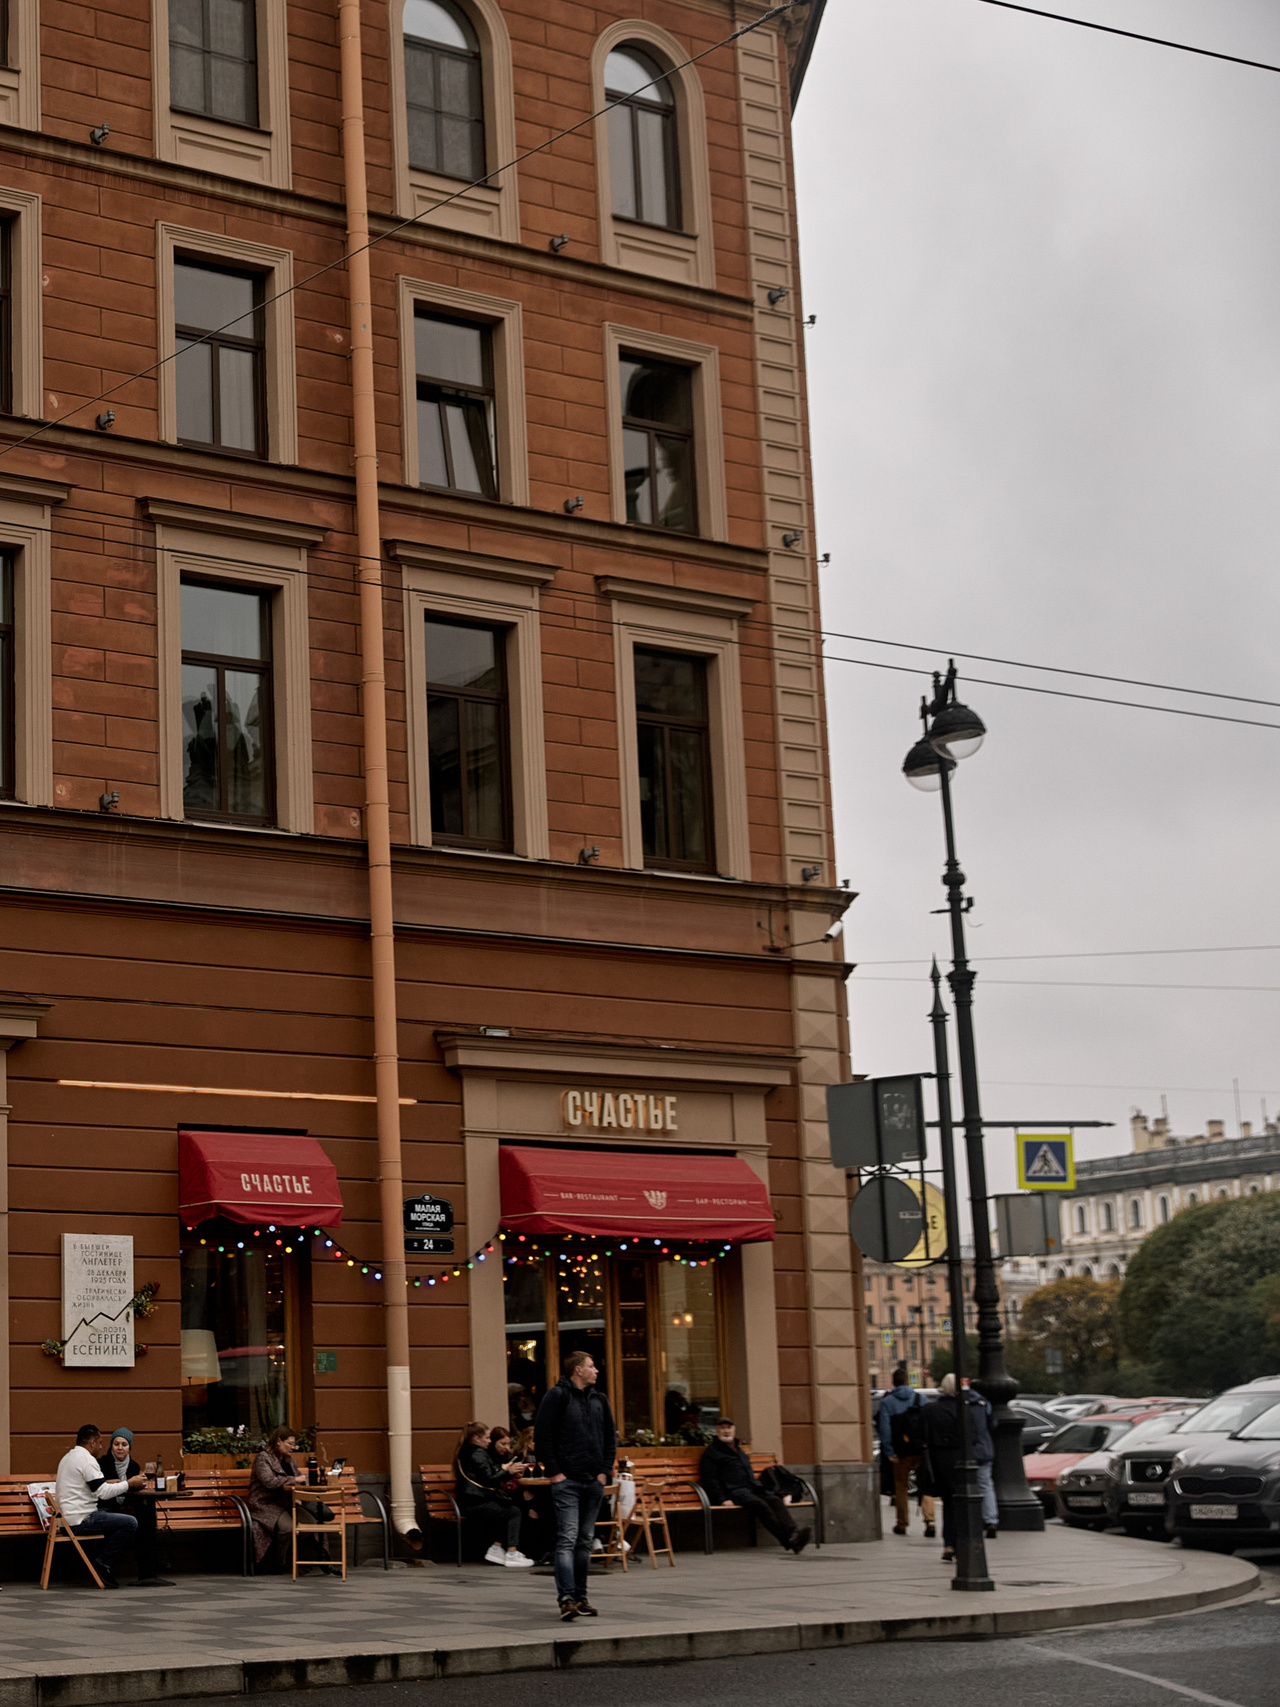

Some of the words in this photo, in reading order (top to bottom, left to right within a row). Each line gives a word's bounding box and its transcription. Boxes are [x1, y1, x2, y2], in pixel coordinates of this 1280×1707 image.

[565, 1090, 679, 1131] СЧАСТЬЕ
[240, 1173, 313, 1195] СЧАСТЬЕ
[414, 1204, 441, 1213] МАЛАЯ
[410, 1212, 446, 1222] МОРСКАЯ
[423, 1239, 434, 1250] 24
[81, 1250, 122, 1258] ГОСТИНИЦЕ
[81, 1257, 123, 1267] АНГЛЕТЕР
[88, 1333, 127, 1344] СЕРГЕЯ
[72, 1345, 127, 1356] ЕСЕНИНА
